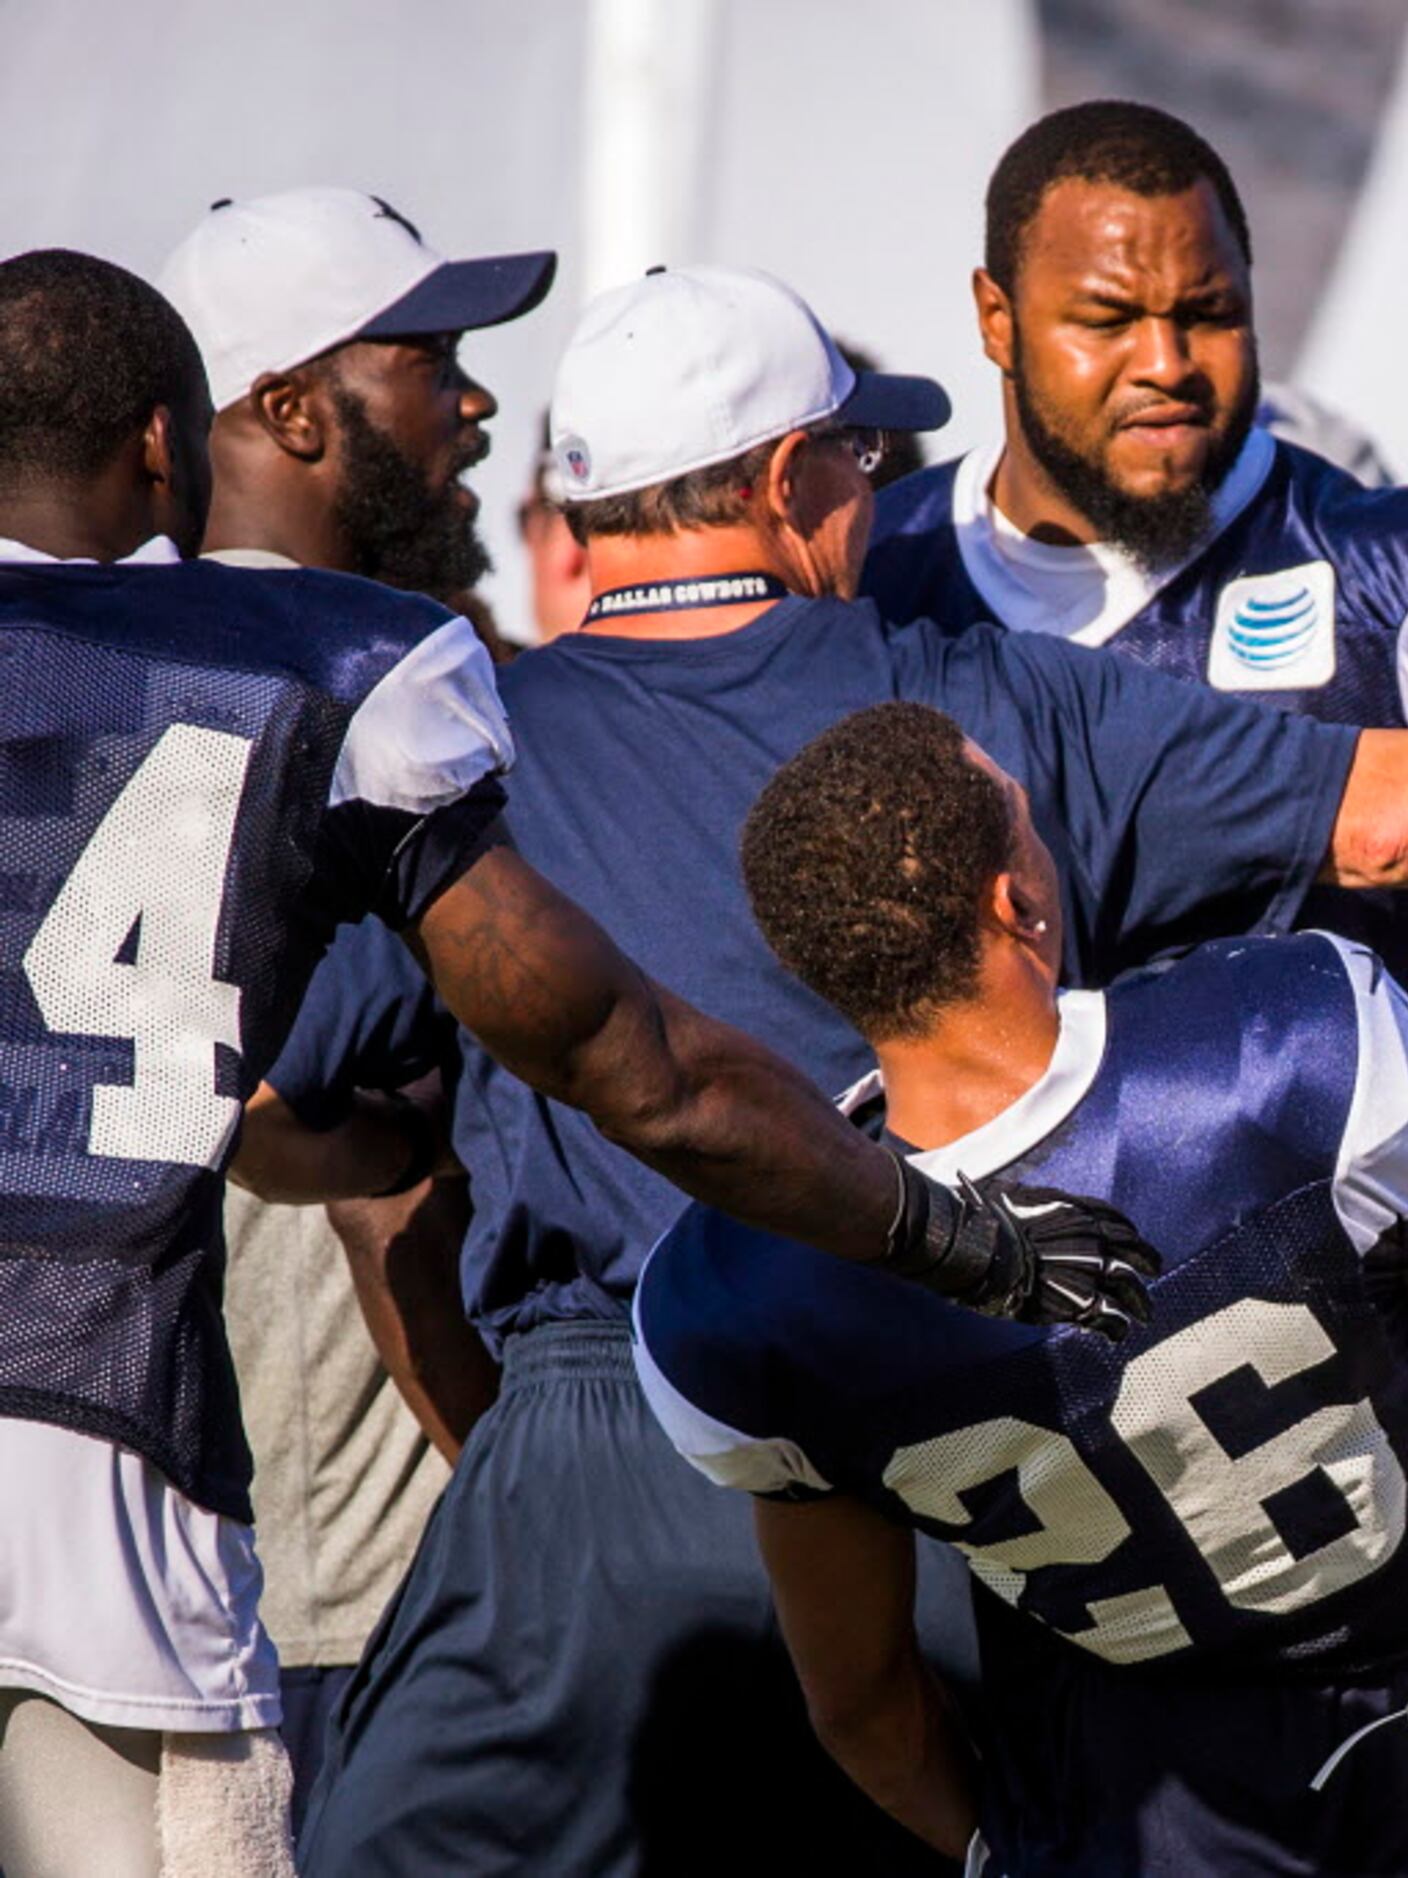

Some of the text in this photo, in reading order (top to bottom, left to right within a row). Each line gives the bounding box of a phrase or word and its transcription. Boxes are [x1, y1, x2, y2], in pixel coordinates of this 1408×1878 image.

[601, 577, 768, 613] DALLAS COWBOYS
[23, 722, 257, 1170] 4
[881, 1297, 1408, 1666] 26
